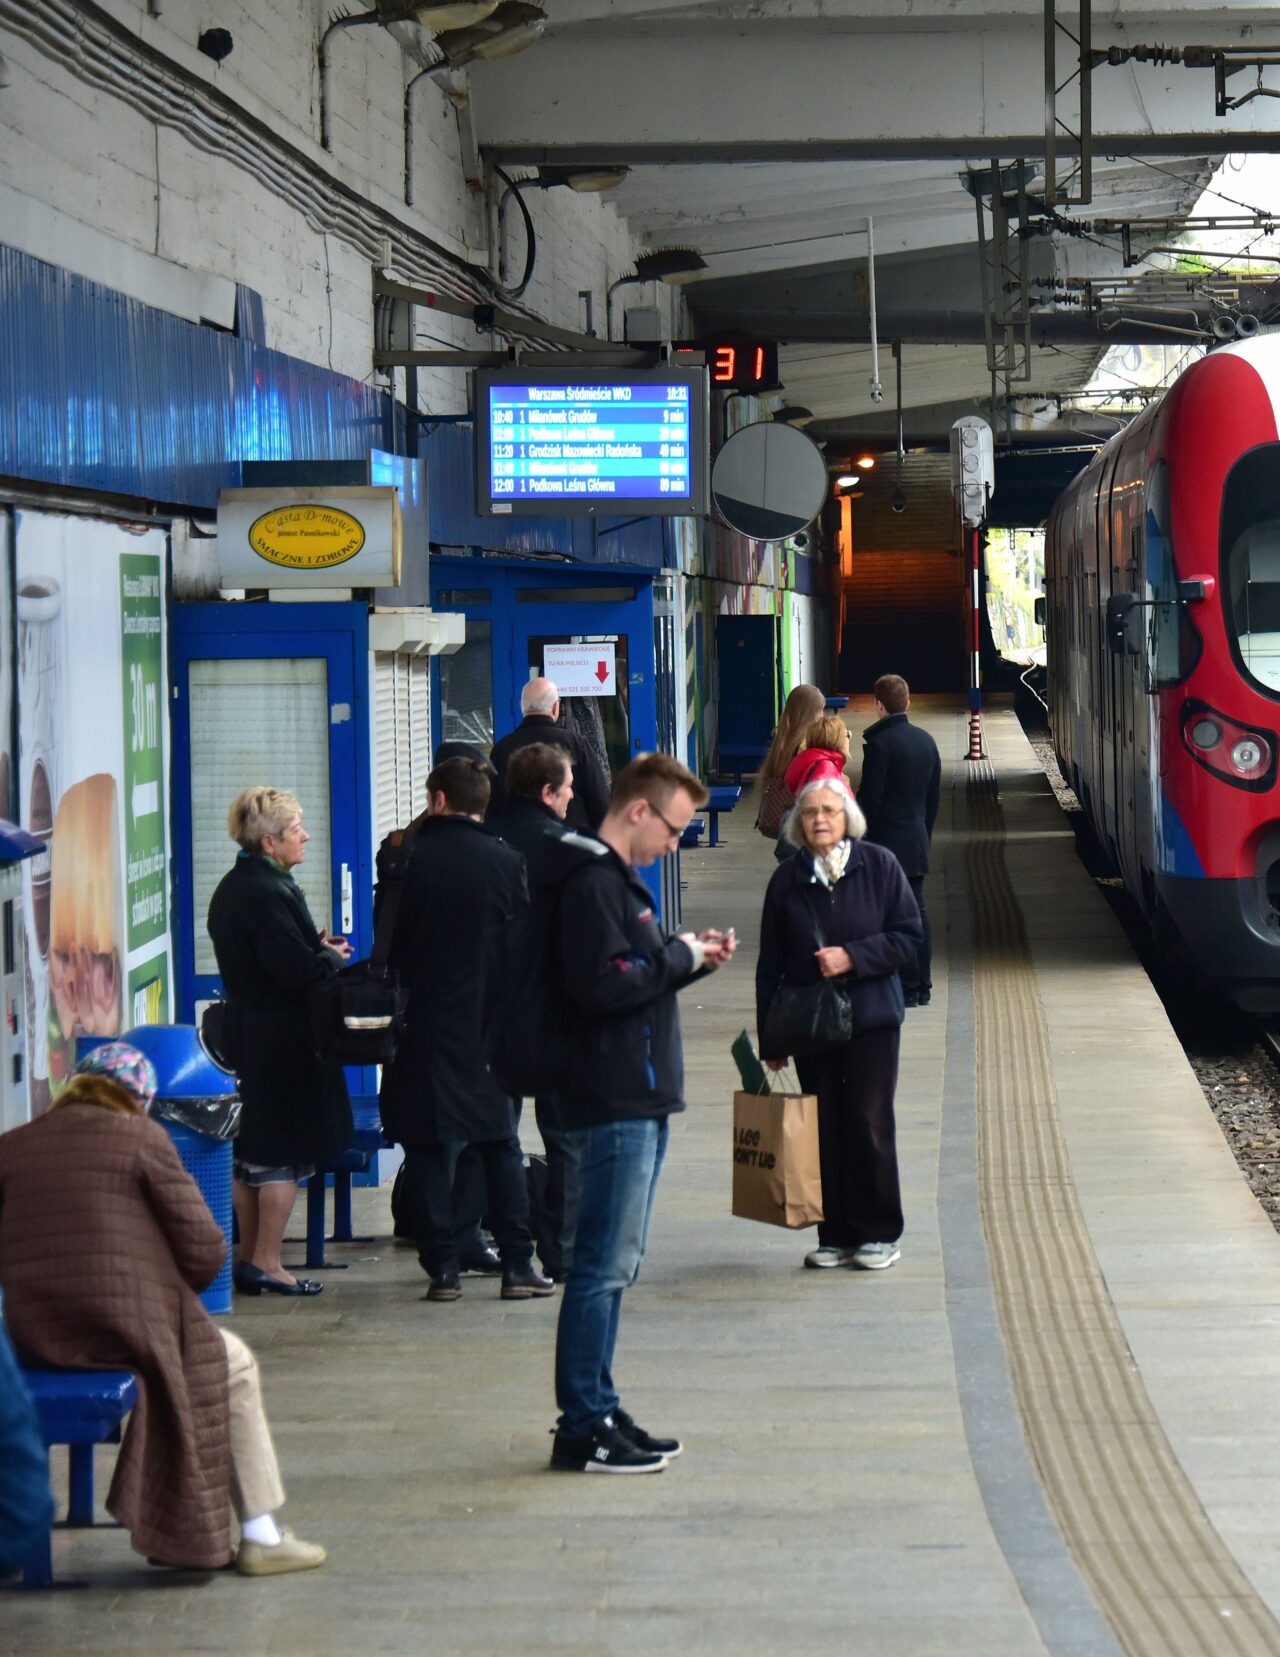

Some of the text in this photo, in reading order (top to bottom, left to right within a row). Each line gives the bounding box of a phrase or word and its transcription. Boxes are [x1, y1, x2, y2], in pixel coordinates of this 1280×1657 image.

[528, 386, 687, 401] Warszawa Śródmieście WKD 10:31
[493, 409, 684, 424] 10:40 1 Milanówek Grudów 9 min
[520, 427, 526, 442] 1
[670, 426, 684, 441] min
[493, 443, 685, 458] 11:20 1 Grodzisk Mazowiecki Radońska 49 min
[521, 461, 526, 475] 1
[670, 460, 685, 475] min
[494, 477, 685, 492] 12:00 1 Podkowa Leśna Główna 89 min
[264, 510, 353, 533] Casta Dmowe
[257, 538, 304, 563] SMACZNE
[315, 538, 358, 563] ZDROWE
[130, 663, 157, 752] 30 m
[733, 1147, 758, 1168] ON'T
